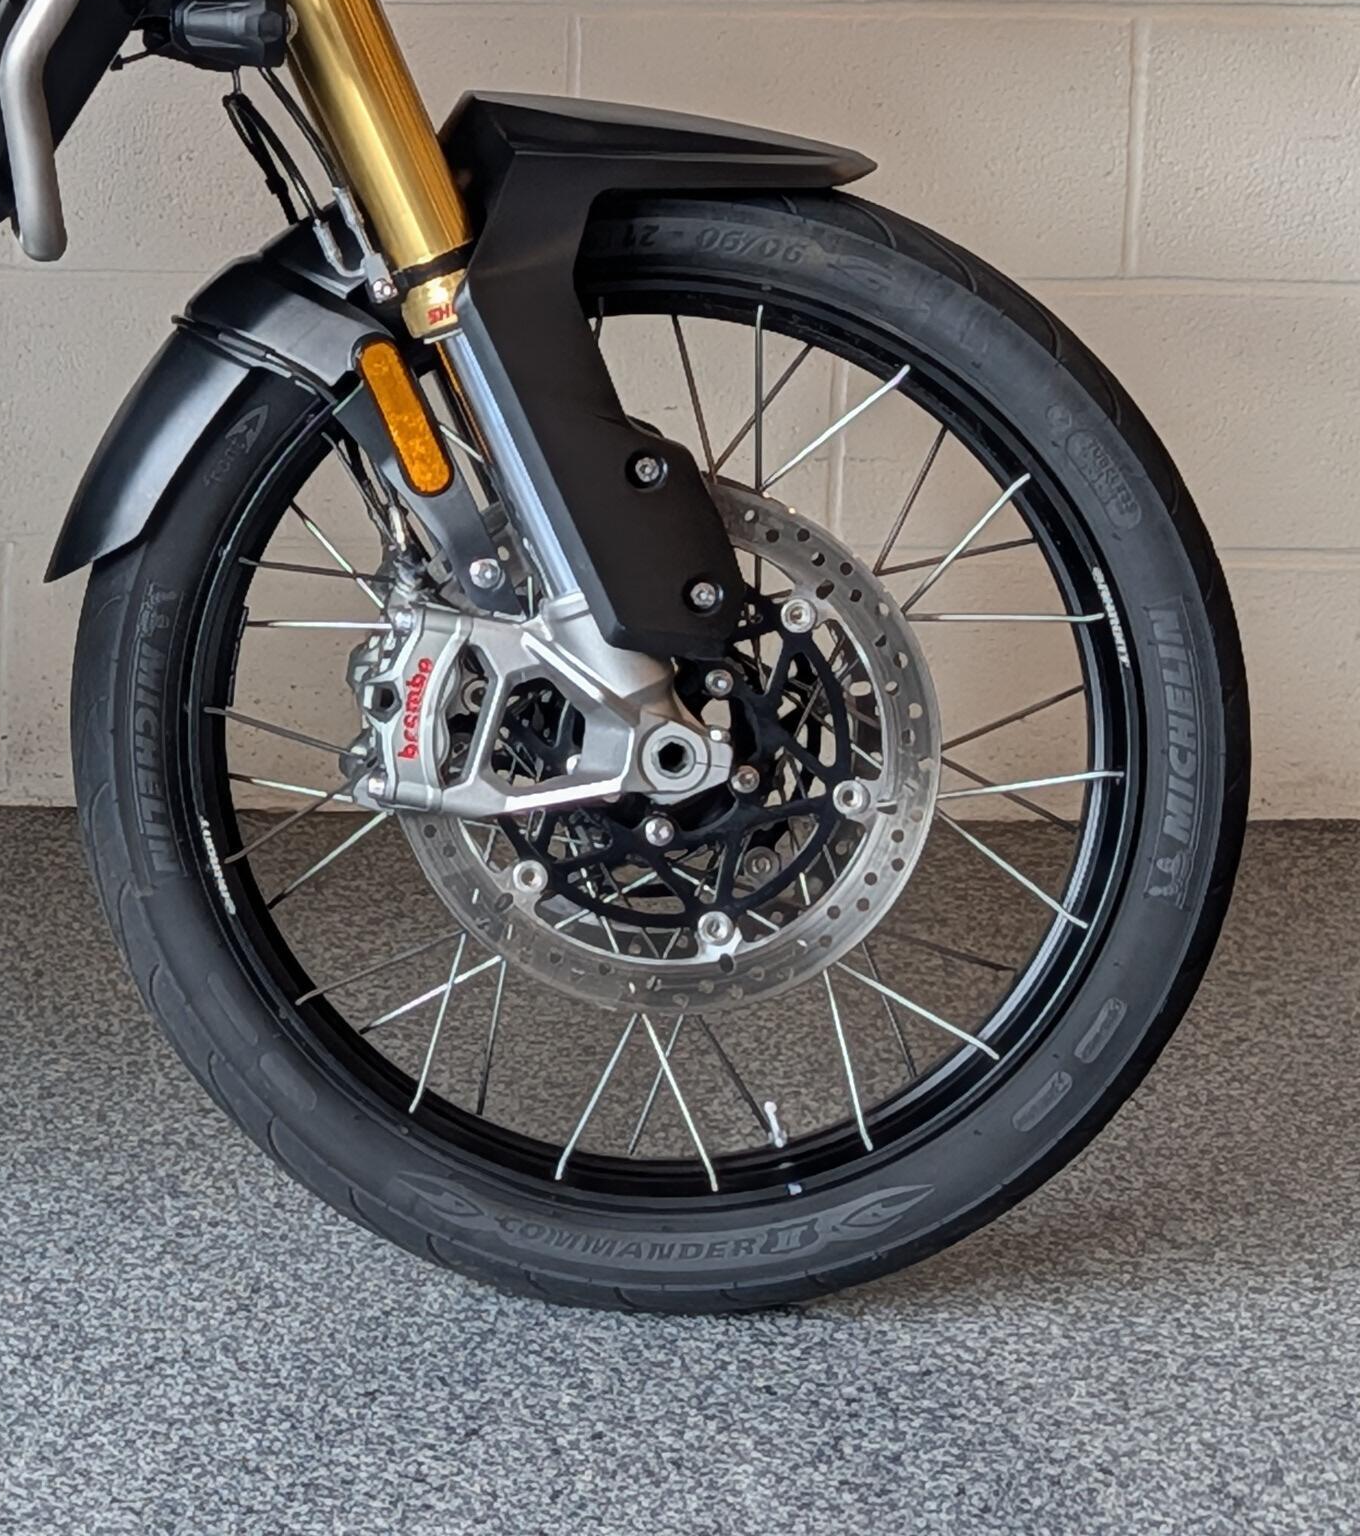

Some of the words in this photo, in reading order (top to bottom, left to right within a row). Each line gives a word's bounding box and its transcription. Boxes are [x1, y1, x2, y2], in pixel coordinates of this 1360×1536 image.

[135, 637, 181, 872] MICHELIN
[397, 657, 433, 760] brembo
[1149, 607, 1198, 844] MICHELIN
[493, 1214, 758, 1261] COMMANDER
